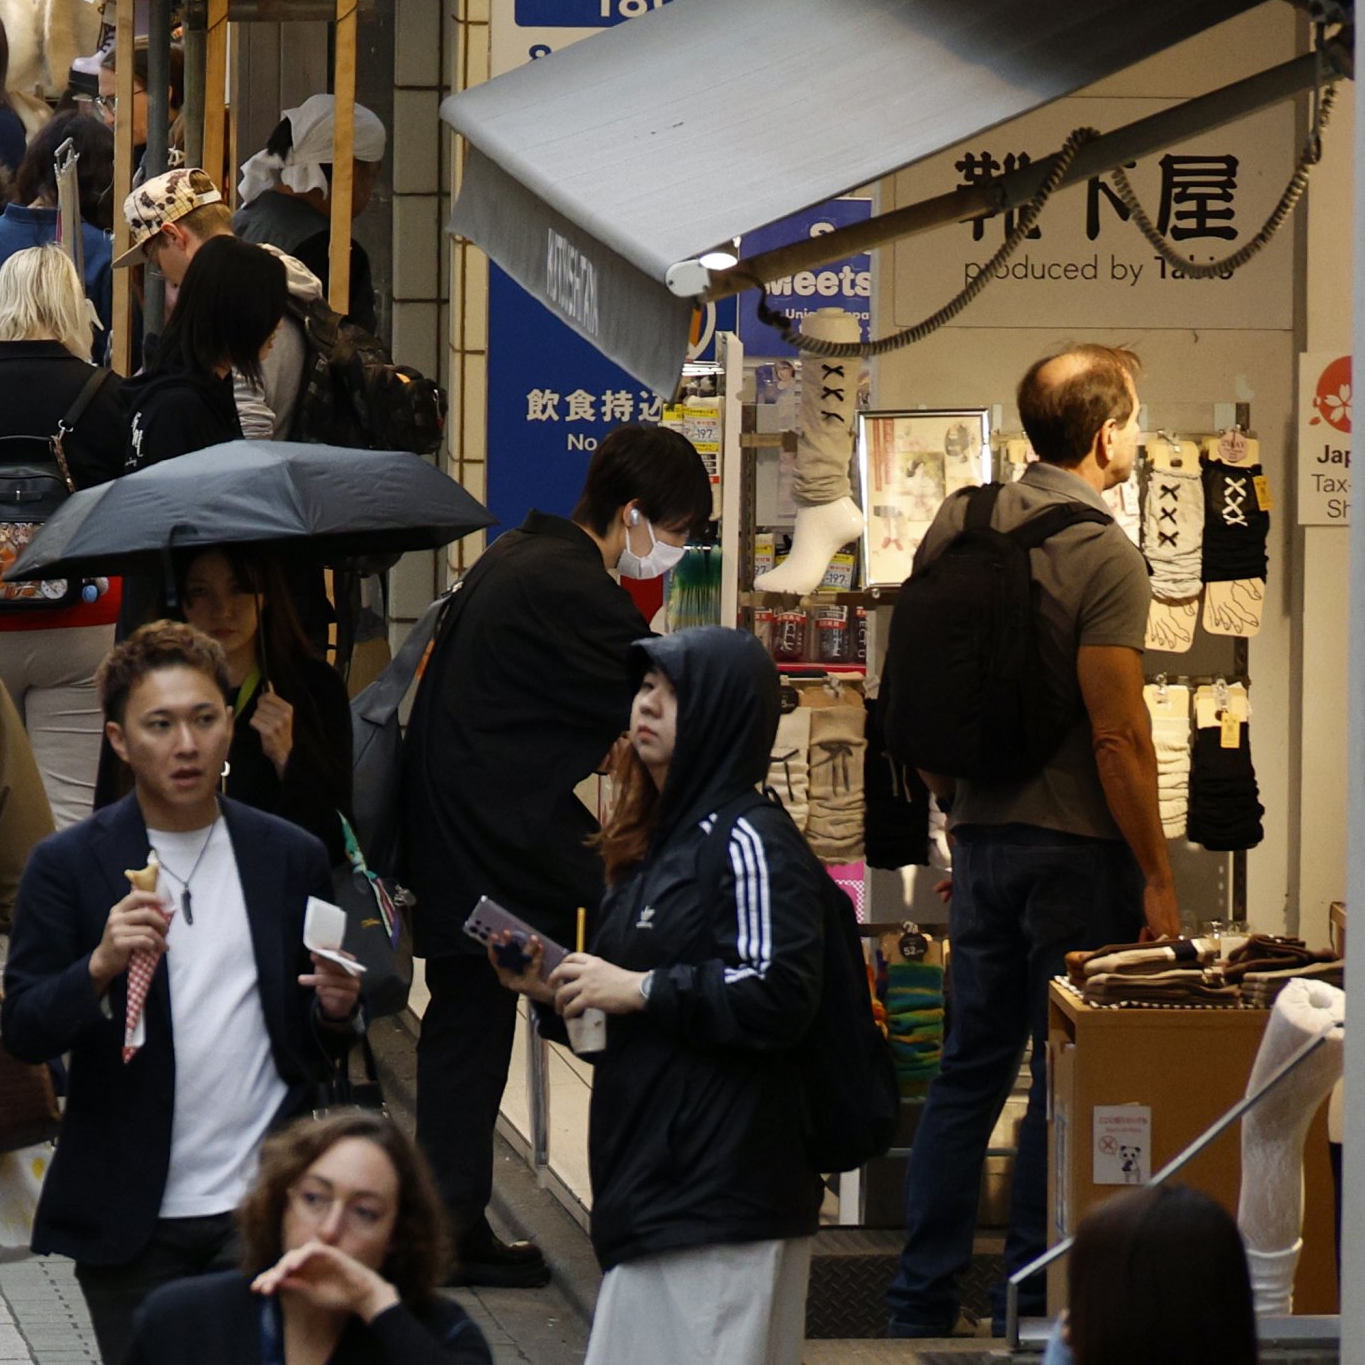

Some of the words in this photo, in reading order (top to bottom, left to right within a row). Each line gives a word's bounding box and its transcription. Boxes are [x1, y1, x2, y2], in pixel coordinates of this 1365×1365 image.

[964, 253, 1098, 286] poduced
[1110, 253, 1143, 287] by
[567, 434, 598, 451] No
